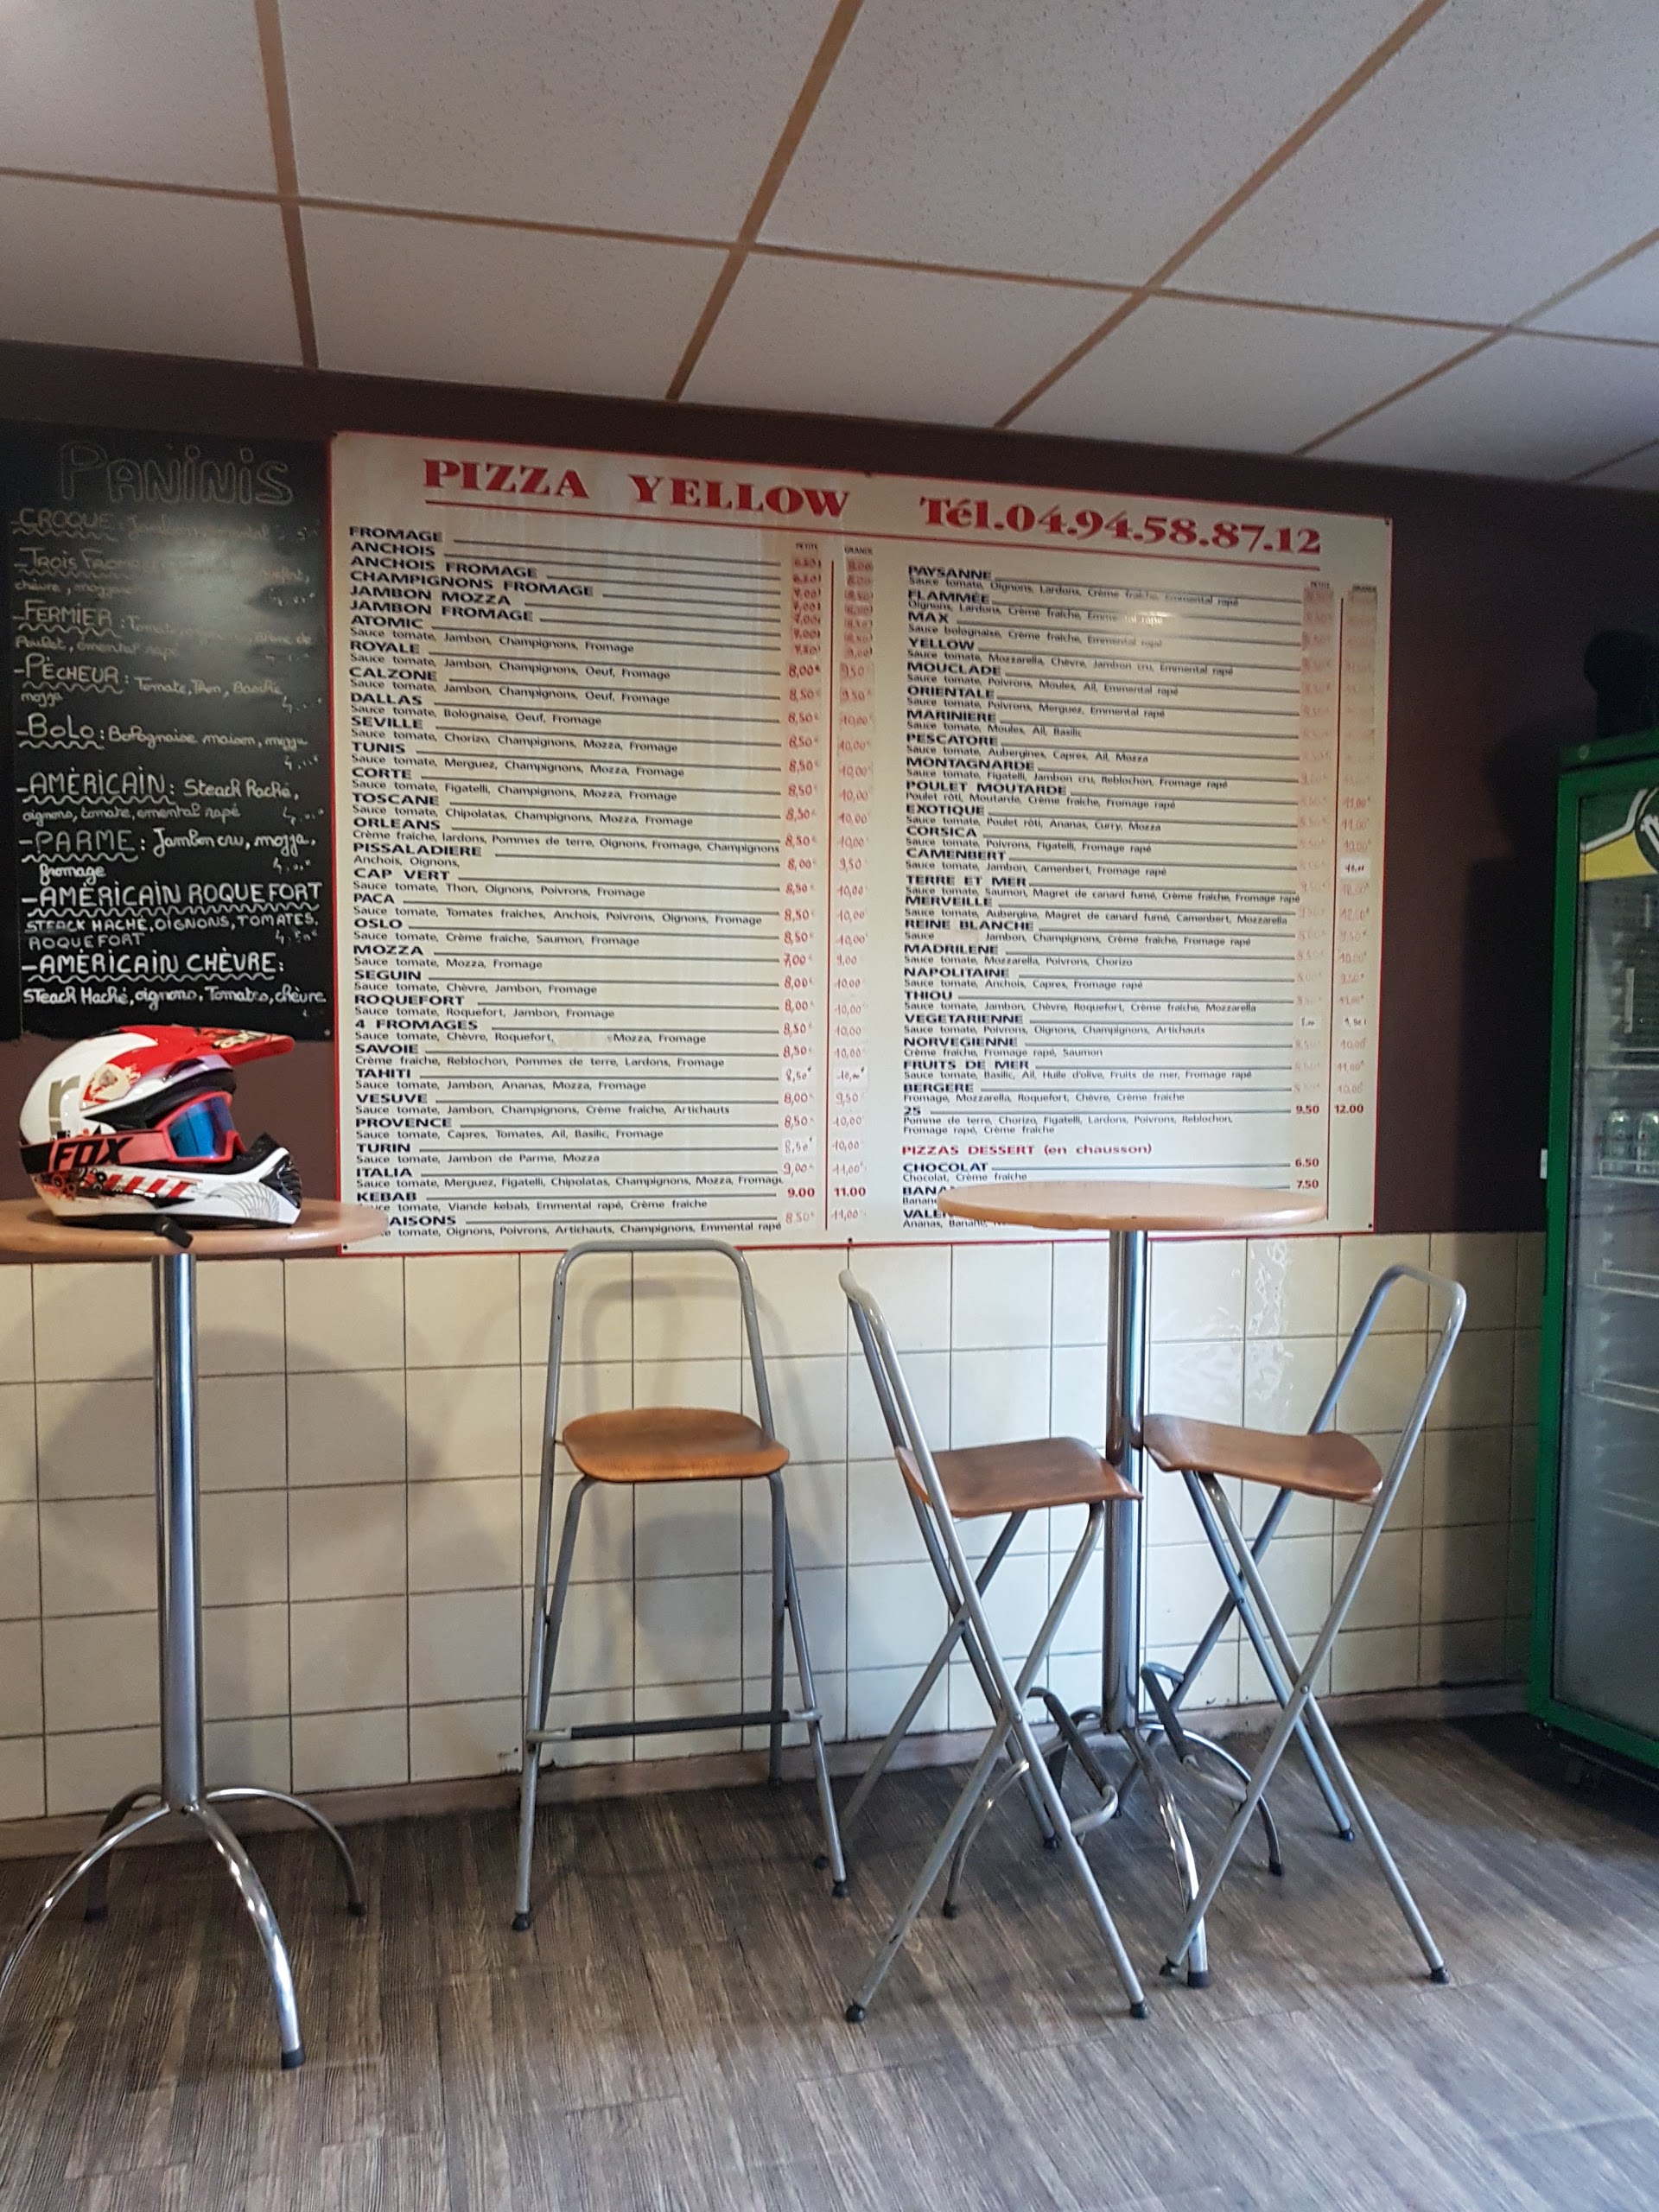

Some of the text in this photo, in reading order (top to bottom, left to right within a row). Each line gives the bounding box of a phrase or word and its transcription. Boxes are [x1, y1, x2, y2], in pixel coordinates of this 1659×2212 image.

[423, 459, 589, 499] PIZZA
[628, 474, 850, 518] YELLOW
[350, 526, 442, 542] FROMAGE
[351, 542, 435, 556] ANCHOIS
[352, 556, 537, 578] ANCHOIS FROMAGE
[909, 566, 992, 580] PAYSANNE
[350, 571, 594, 596] CHAMPIGNONS FROMAGE
[351, 586, 511, 605] JAMBON MOZZA
[350, 601, 533, 621] JAMBON FROMAGE
[351, 615, 423, 629] ATOMIC
[909, 612, 949, 624] MAX
[350, 641, 420, 654] ROYALE
[909, 639, 975, 650] YELLOW
[350, 667, 437, 681] CALZONE
[907, 663, 1001, 676] MOUCLADE
[908, 686, 994, 699] ORIENTALE
[351, 693, 422, 705] DALLAS
[907, 710, 995, 722] MARINIERE
[351, 717, 423, 729] SEVILLE
[906, 733, 998, 746] PESCATORE
[353, 742, 405, 754] TUNIS
[907, 757, 1034, 771] MONTAGNARDE
[353, 767, 412, 779] CORTE
[906, 780, 1066, 795] POULET MOUTARDE
[353, 793, 439, 805] TOSCANE
[907, 804, 984, 816] EXOTIQUE
[353, 817, 441, 830] ORLEANS
[906, 826, 977, 837] CORSICA
[154, 828, 215, 857] Jambon
[353, 843, 481, 856] PISSALADIERE
[907, 849, 1006, 861] CAMENBERT
[354, 868, 449, 880] CAP VERT
[906, 874, 1026, 887] TERRE ET MER
[353, 893, 395, 904] PACA
[906, 896, 992, 907] MERVEILLE
[354, 918, 402, 929] OSLO
[906, 919, 1033, 931] REINE BLANCHE
[353, 945, 423, 955] MOZZA
[904, 944, 998, 955] MADRILENE
[354, 970, 422, 981] SEGUIN
[904, 968, 1008, 978] NAPOLITAINE
[354, 995, 465, 1006] ROQUEFORT
[905, 991, 952, 1001] THIOU
[905, 1014, 1023, 1024] VEGETARIENNE
[356, 1020, 478, 1031] 4 FROMAGES
[904, 1037, 1018, 1047] NORVEGIENNE
[356, 1044, 418, 1054] SAVOIE
[903, 1060, 1029, 1070] FRUITS DE MER
[356, 1069, 410, 1078] TAHITI
[903, 1084, 974, 1093] BERGERE
[356, 1094, 428, 1103] VESUVE
[904, 1104, 1363, 1116] 25 9.50 12.00
[356, 1118, 452, 1128] PROVENCE
[54, 1137, 135, 1171] FOX
[356, 1144, 410, 1153] TURIN
[902, 1144, 1152, 1156] PIZZAS DESSERT (en chausson)
[903, 1158, 1319, 1173] CHOCOLAT 6.50
[356, 1168, 413, 1178] ITALIA
[1297, 1180, 1319, 1189] 7.50
[357, 1187, 866, 1201] KEBAB 9.00 11.00
